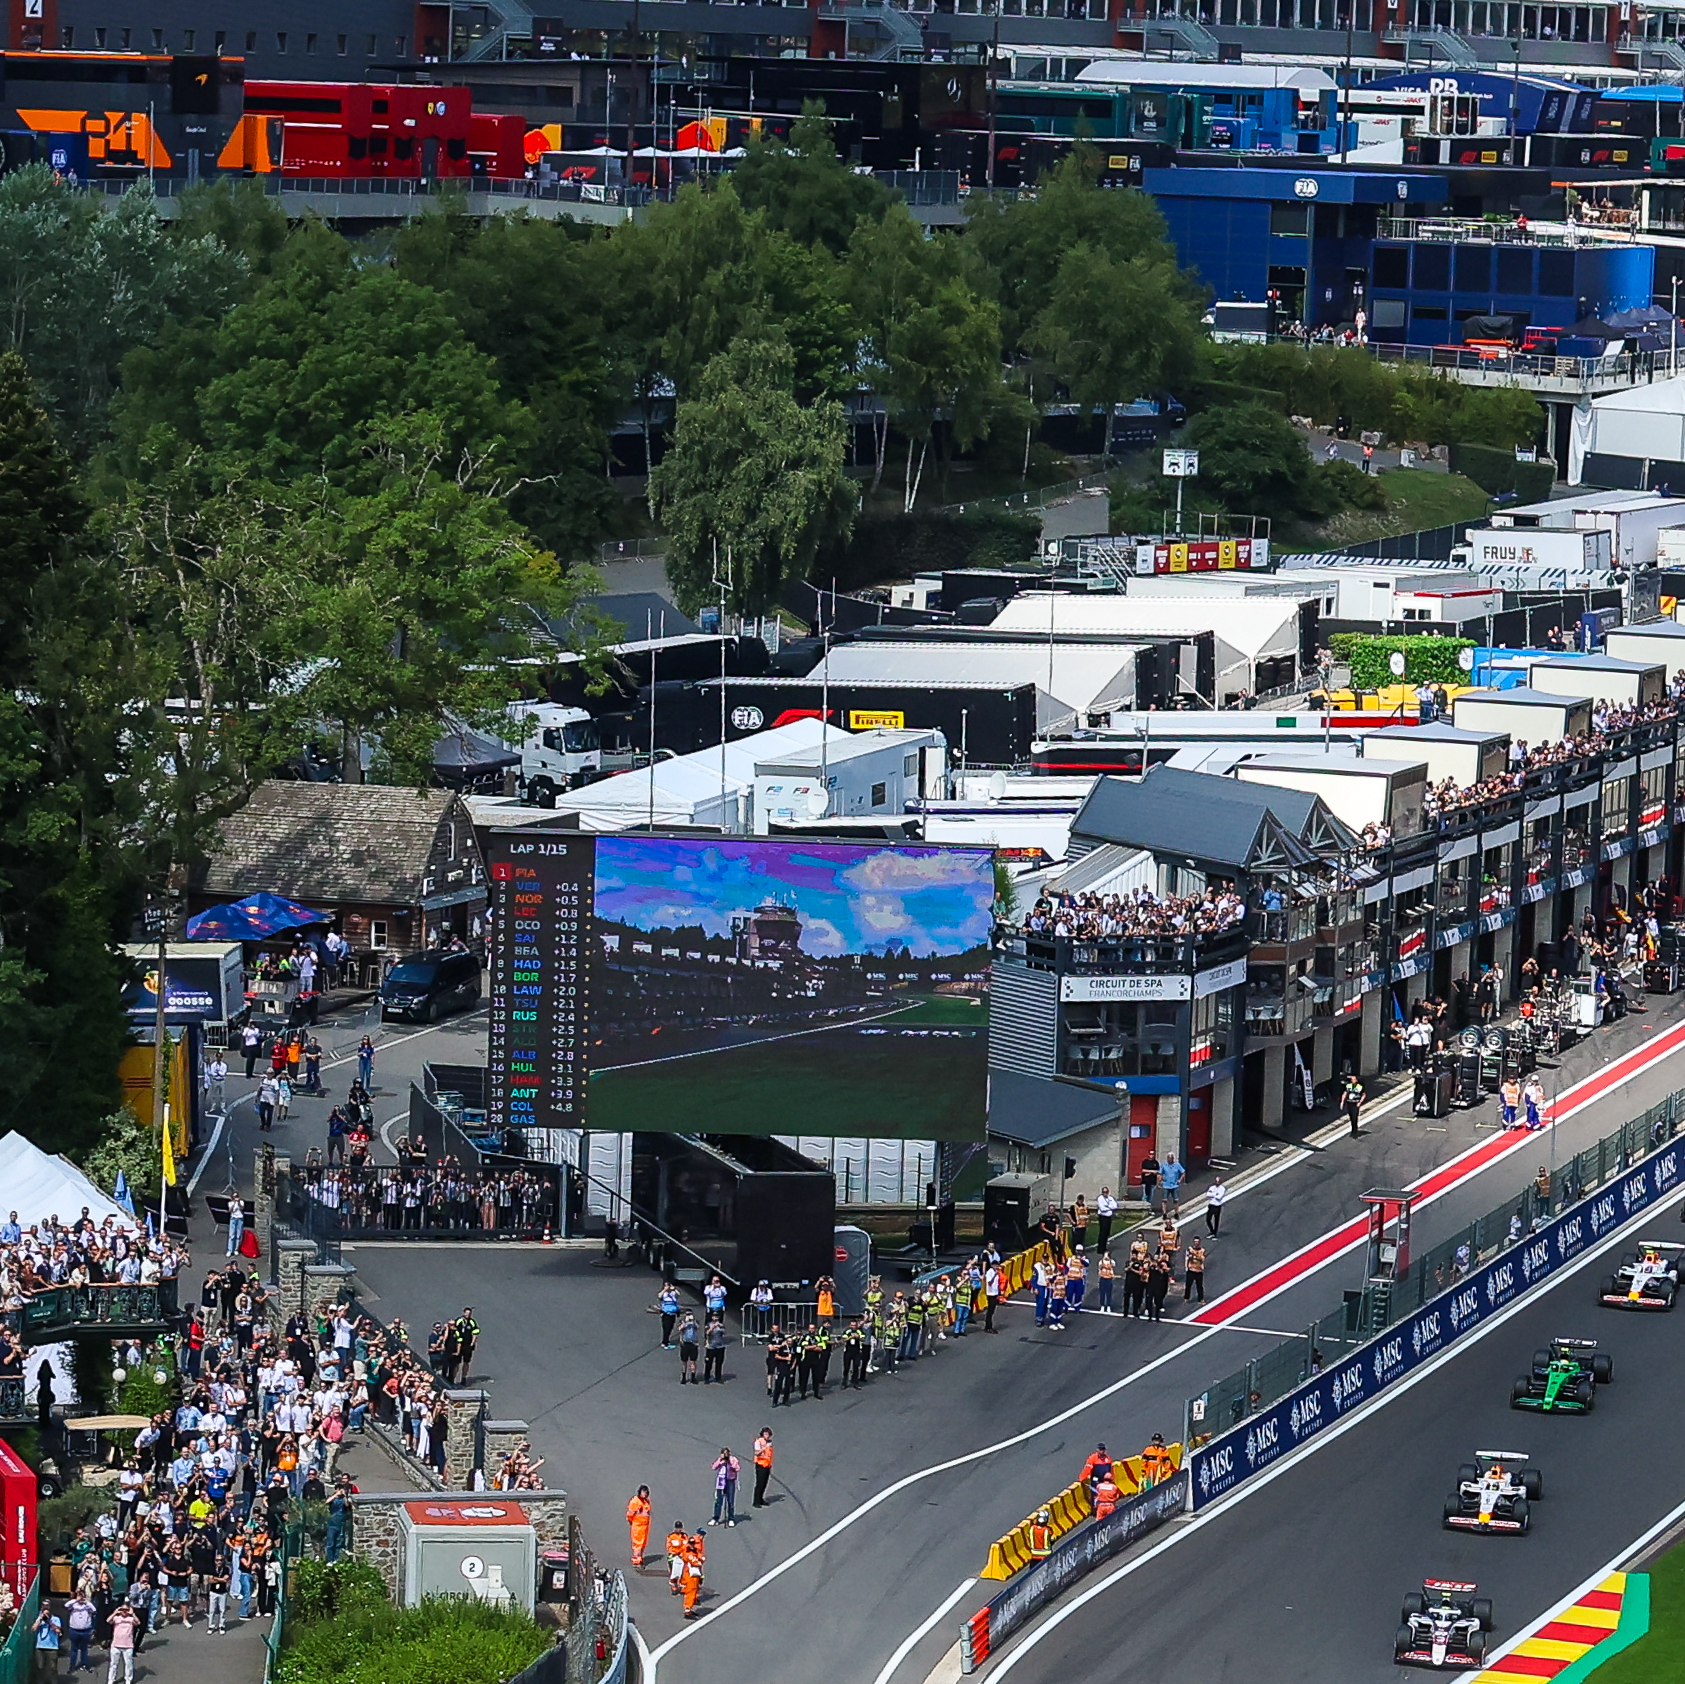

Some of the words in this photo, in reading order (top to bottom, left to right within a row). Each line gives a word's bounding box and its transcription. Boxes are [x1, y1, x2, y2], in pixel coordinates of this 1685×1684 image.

[1483, 545, 1516, 560] FRUY
[510, 844, 535, 854] LAP
[538, 844, 568, 856] 1/15
[515, 894, 543, 904] NOR
[515, 920, 540, 930] OCO
[514, 934, 535, 943] SAI
[514, 946, 540, 955] BEA
[513, 960, 542, 969] HAD
[513, 972, 539, 982] BOR
[1089, 980, 1128, 989] CIRCUIT
[1130, 980, 1142, 988] DE
[1144, 979, 1163, 988] SPA
[493, 985, 506, 994] 10
[513, 985, 542, 995] LAW
[1089, 989, 1164, 998] FRANCORCHAMPS
[493, 998, 505, 1007] 11
[493, 1011, 505, 1020] 12
[513, 1011, 537, 1020] RUS
[492, 1023, 505, 1033] 13
[492, 1036, 505, 1045] 14
[492, 1050, 505, 1058] 15
[492, 1063, 504, 1071] 16
[511, 1063, 536, 1072] HUL
[491, 1076, 504, 1084] 17
[491, 1089, 503, 1097] 18
[510, 1088, 538, 1098] ANT
[491, 1102, 503, 1110] 19
[510, 1102, 533, 1111] COL
[490, 1114, 503, 1123] 20
[510, 1115, 536, 1124] GAS
[1459, 1286, 1478, 1318] MSC
[1421, 1311, 1440, 1344] MSC
[1383, 1337, 1402, 1370] MSC
[1343, 1363, 1363, 1397] MSC
[1300, 1390, 1321, 1424] MSC
[1256, 1417, 1278, 1453] MSC
[1211, 1446, 1233, 1480] MSC
[1130, 1502, 1148, 1528] MSC
[1093, 1526, 1111, 1552] MSC
